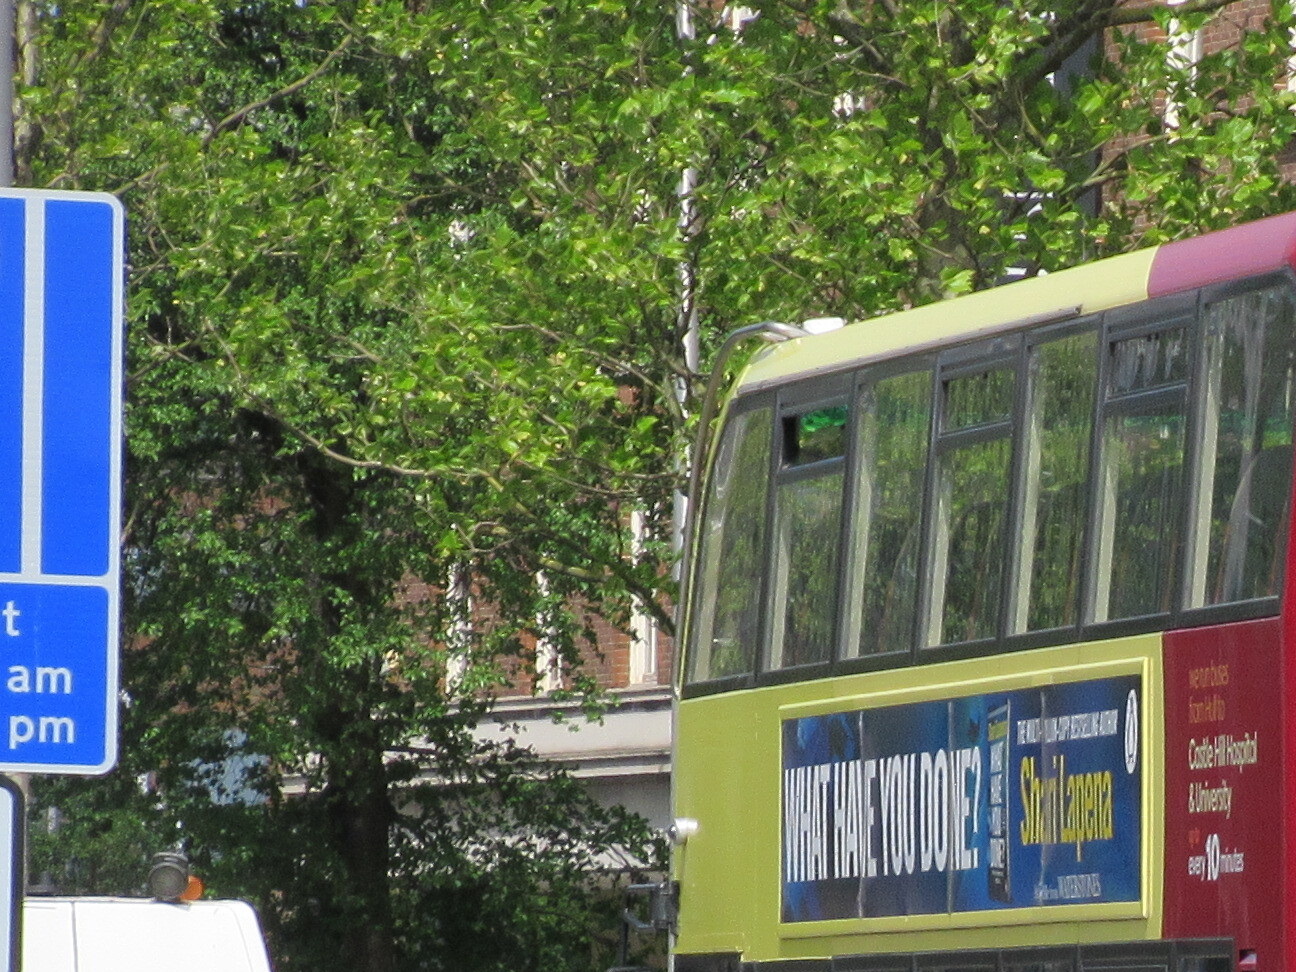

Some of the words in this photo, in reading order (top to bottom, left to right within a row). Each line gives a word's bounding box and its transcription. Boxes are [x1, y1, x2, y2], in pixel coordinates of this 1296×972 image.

[6, 665, 73, 694] am
[9, 715, 75, 750] pm
[1188, 735, 1213, 771] Castle
[1213, 734, 1227, 768] Hill
[1227, 731, 1258, 775] Hospital
[785, 763, 831, 882] WHAT
[834, 759, 877, 879] HAVE
[880, 752, 917, 876] YOU
[920, 746, 982, 873] DONE?
[1060, 755, 1114, 863] Lapena
[1195, 779, 1232, 820] University
[1205, 833, 1220, 881] 10
